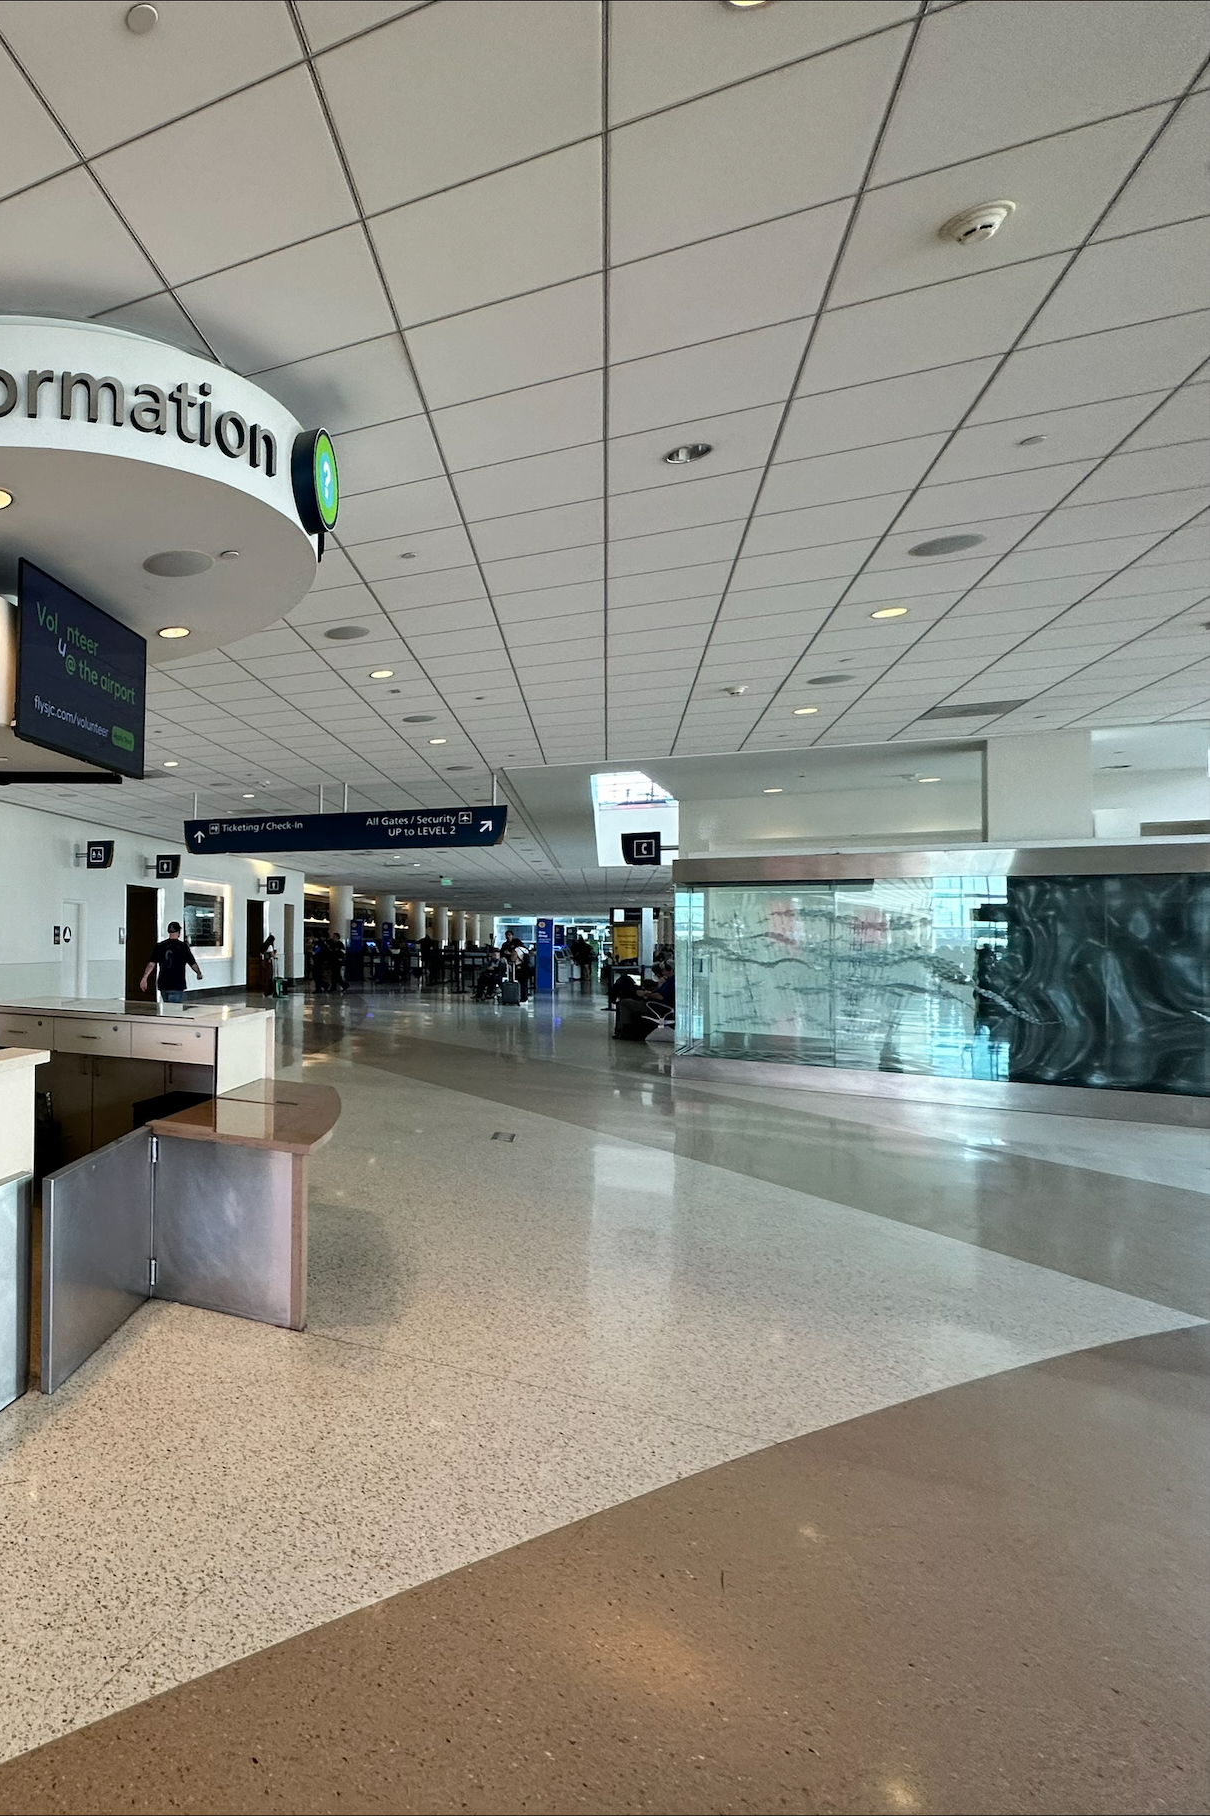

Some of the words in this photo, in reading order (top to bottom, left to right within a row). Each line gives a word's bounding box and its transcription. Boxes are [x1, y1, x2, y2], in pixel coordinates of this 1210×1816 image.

[323, 461, 332, 500] ?
[65, 654, 77, 676] @
[78, 660, 99, 687] the
[100, 672, 136, 706] airport
[33, 695, 110, 739] flysjc.com/volunteer
[221, 823, 260, 833] Ticketing
[266, 820, 304, 831] Check-In
[365, 817, 379, 826] All
[381, 816, 409, 826] Gates
[416, 814, 457, 825] Security
[388, 827, 402, 837] UP
[404, 828, 416, 836] to
[417, 826, 448, 836] LEVEL
[449, 825, 457, 835] 2
